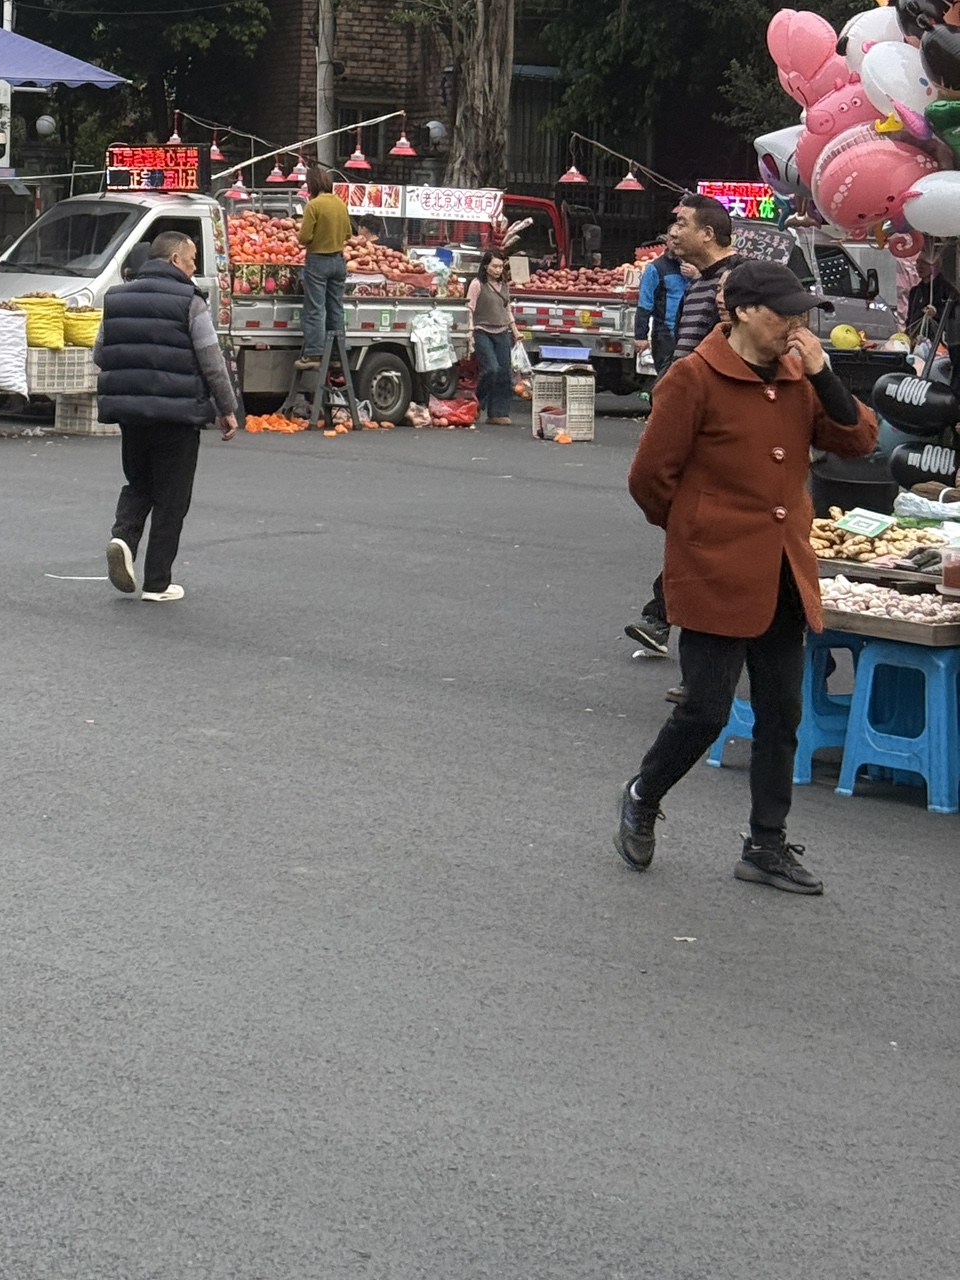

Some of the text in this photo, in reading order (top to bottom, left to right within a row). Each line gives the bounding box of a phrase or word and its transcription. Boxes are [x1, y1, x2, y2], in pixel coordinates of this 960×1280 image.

[422, 191, 495, 212] 老北京冰糖葫芦
